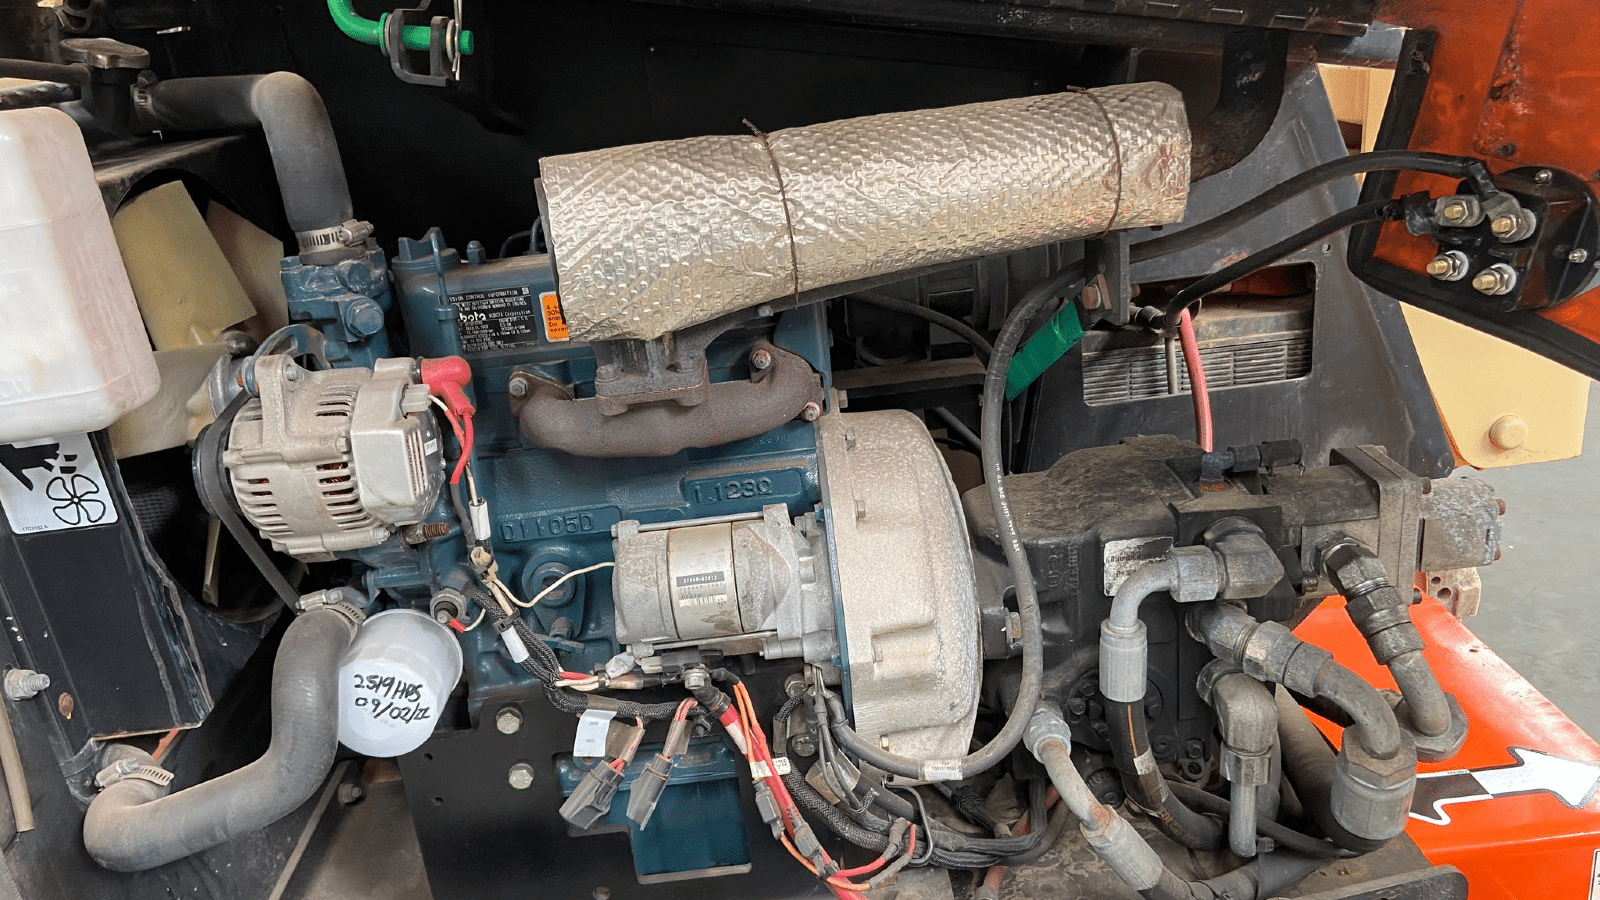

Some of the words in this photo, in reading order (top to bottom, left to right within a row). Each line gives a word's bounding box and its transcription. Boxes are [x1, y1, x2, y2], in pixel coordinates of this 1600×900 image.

[465, 293, 485, 301] CONTROL
[487, 290, 518, 298] INFORMATION
[500, 511, 595, 542] D1105D
